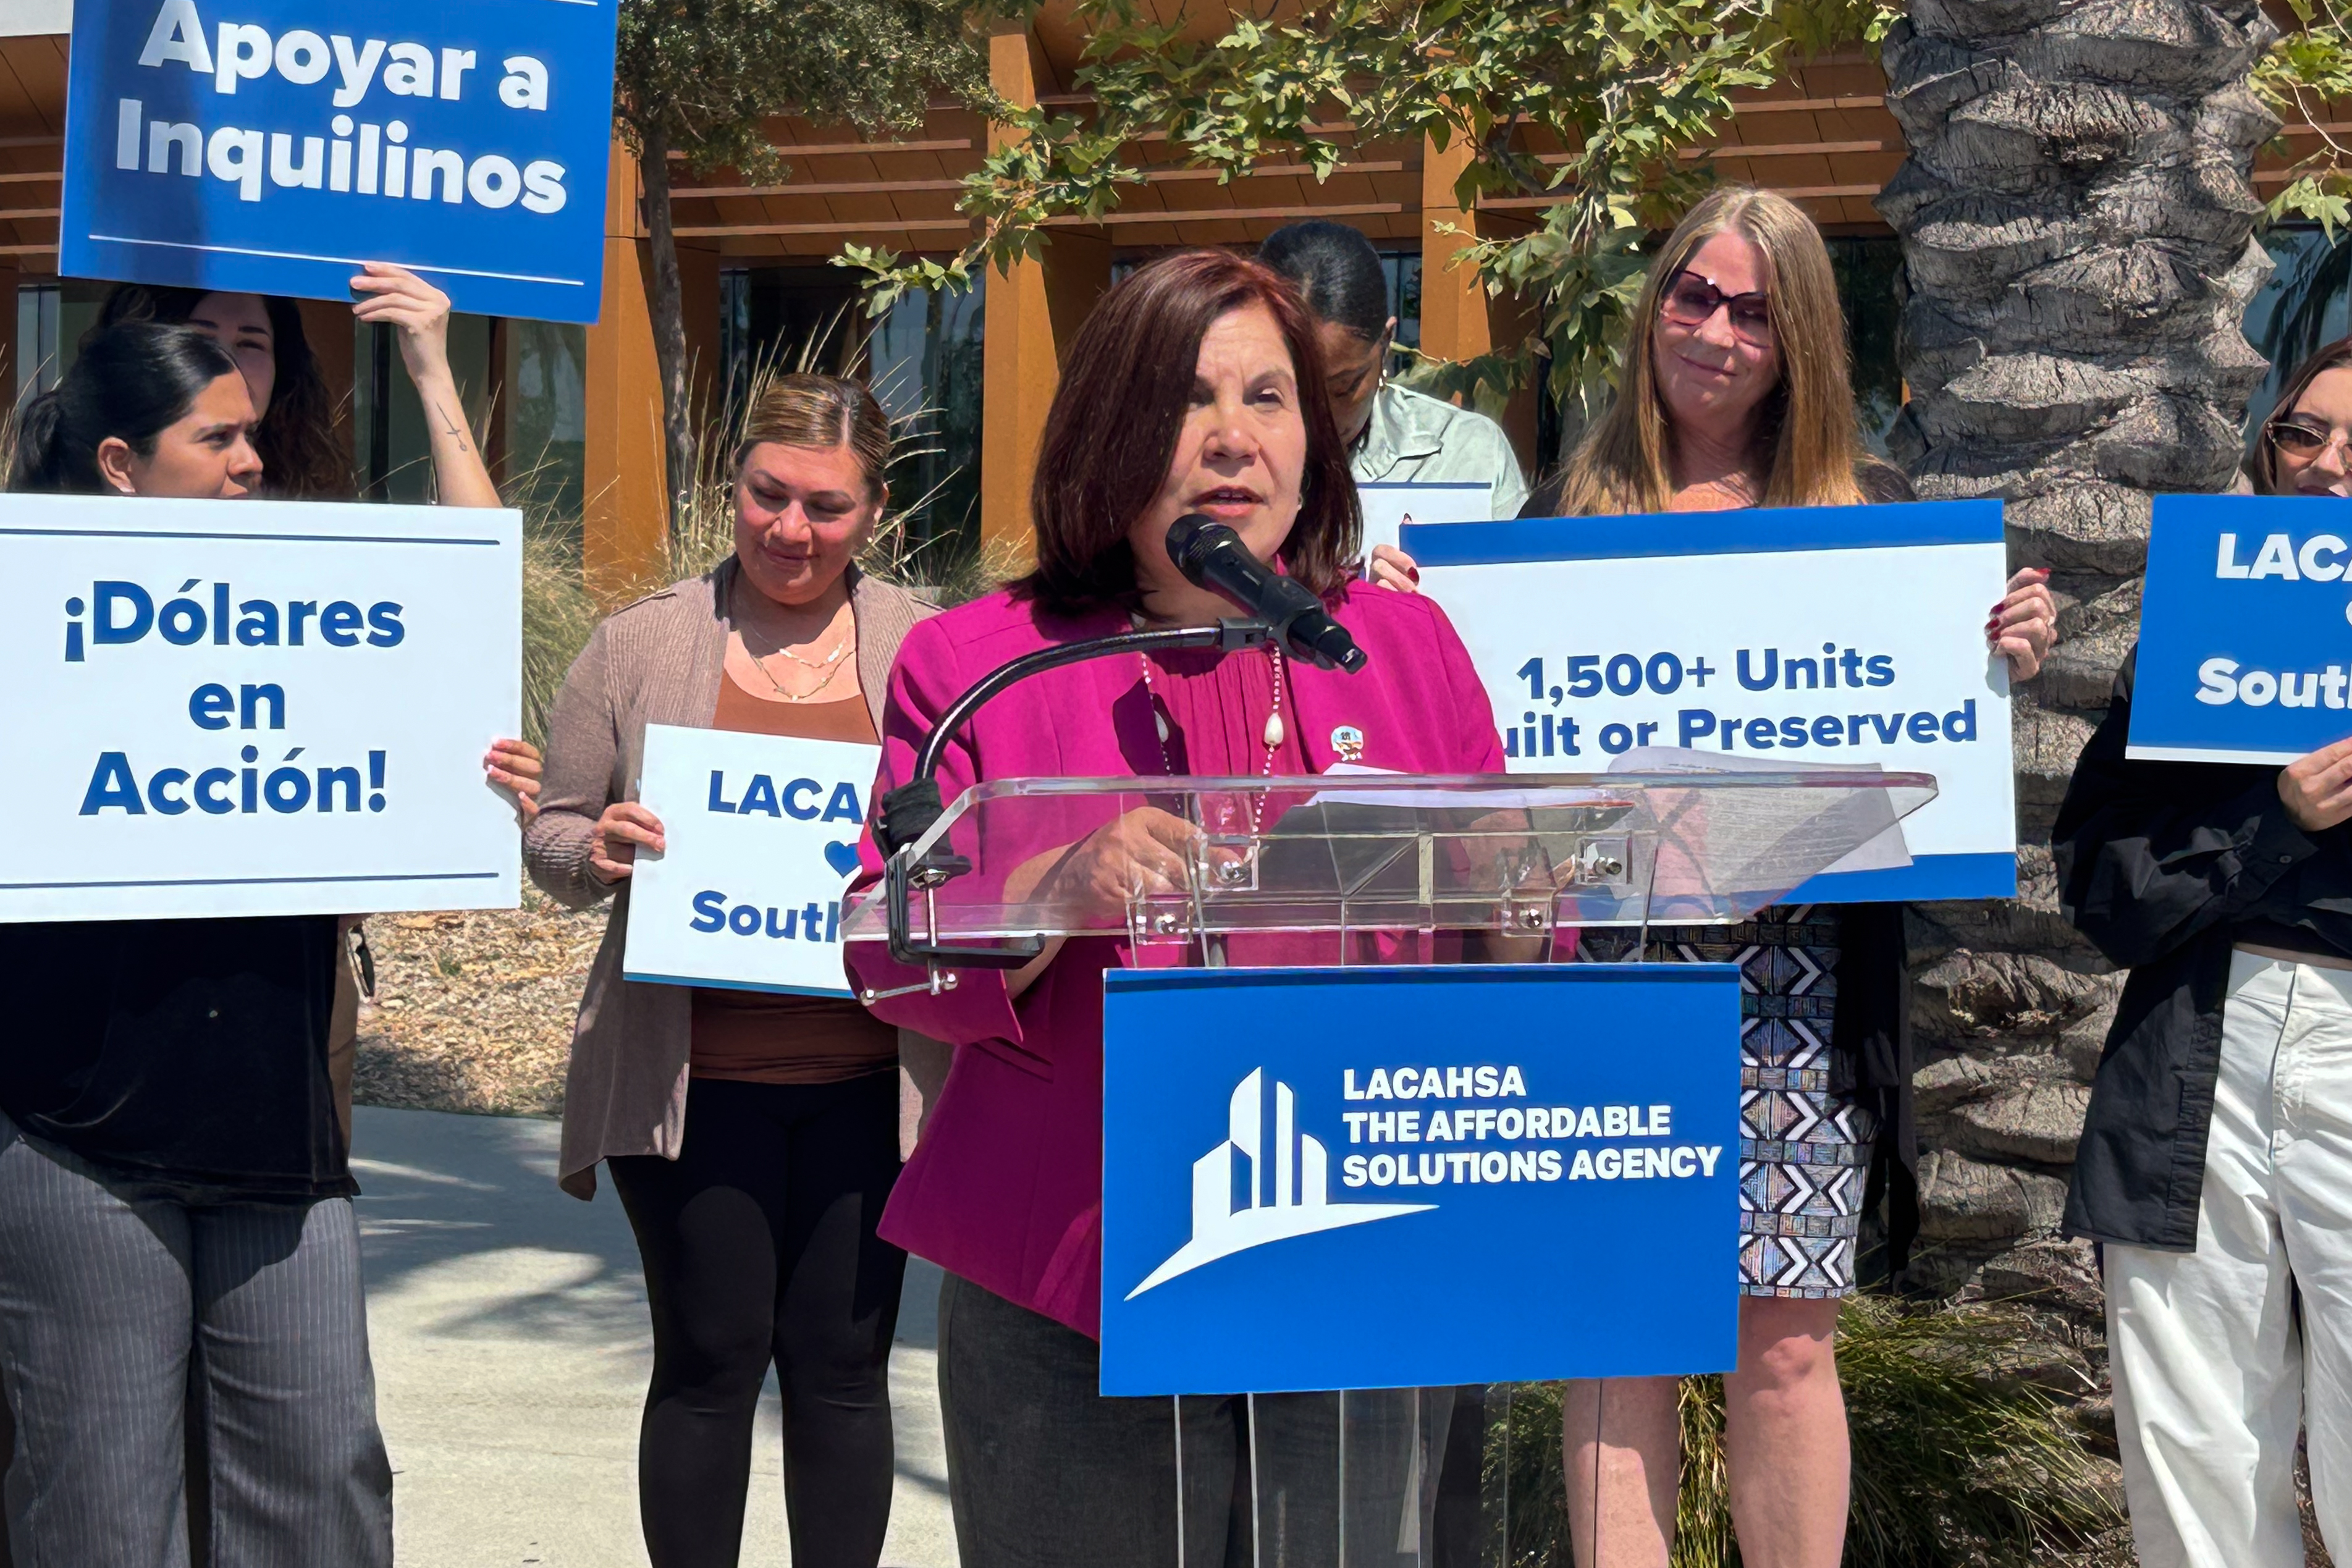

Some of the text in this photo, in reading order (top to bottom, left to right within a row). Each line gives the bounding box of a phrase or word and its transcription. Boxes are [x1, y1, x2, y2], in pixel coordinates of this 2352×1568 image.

[138, 0, 549, 111] Apoyar a
[117, 98, 567, 214] Inquilinos
[2216, 533, 2352, 582] LAC
[65, 578, 405, 662] ¡Dólares
[1516, 642, 1895, 707] 1,500+ Units
[2195, 657, 2352, 709] Sout
[188, 683, 285, 730] en
[1598, 721, 1658, 754] or
[1678, 698, 1976, 751] Preserved
[78, 744, 386, 816] Acción!
[1344, 1065, 1527, 1100] LACAHSA
[1342, 1105, 1671, 1144] THE AFFORDABLE
[1342, 1145, 1722, 1187] SOLUTIONS AGENCY
